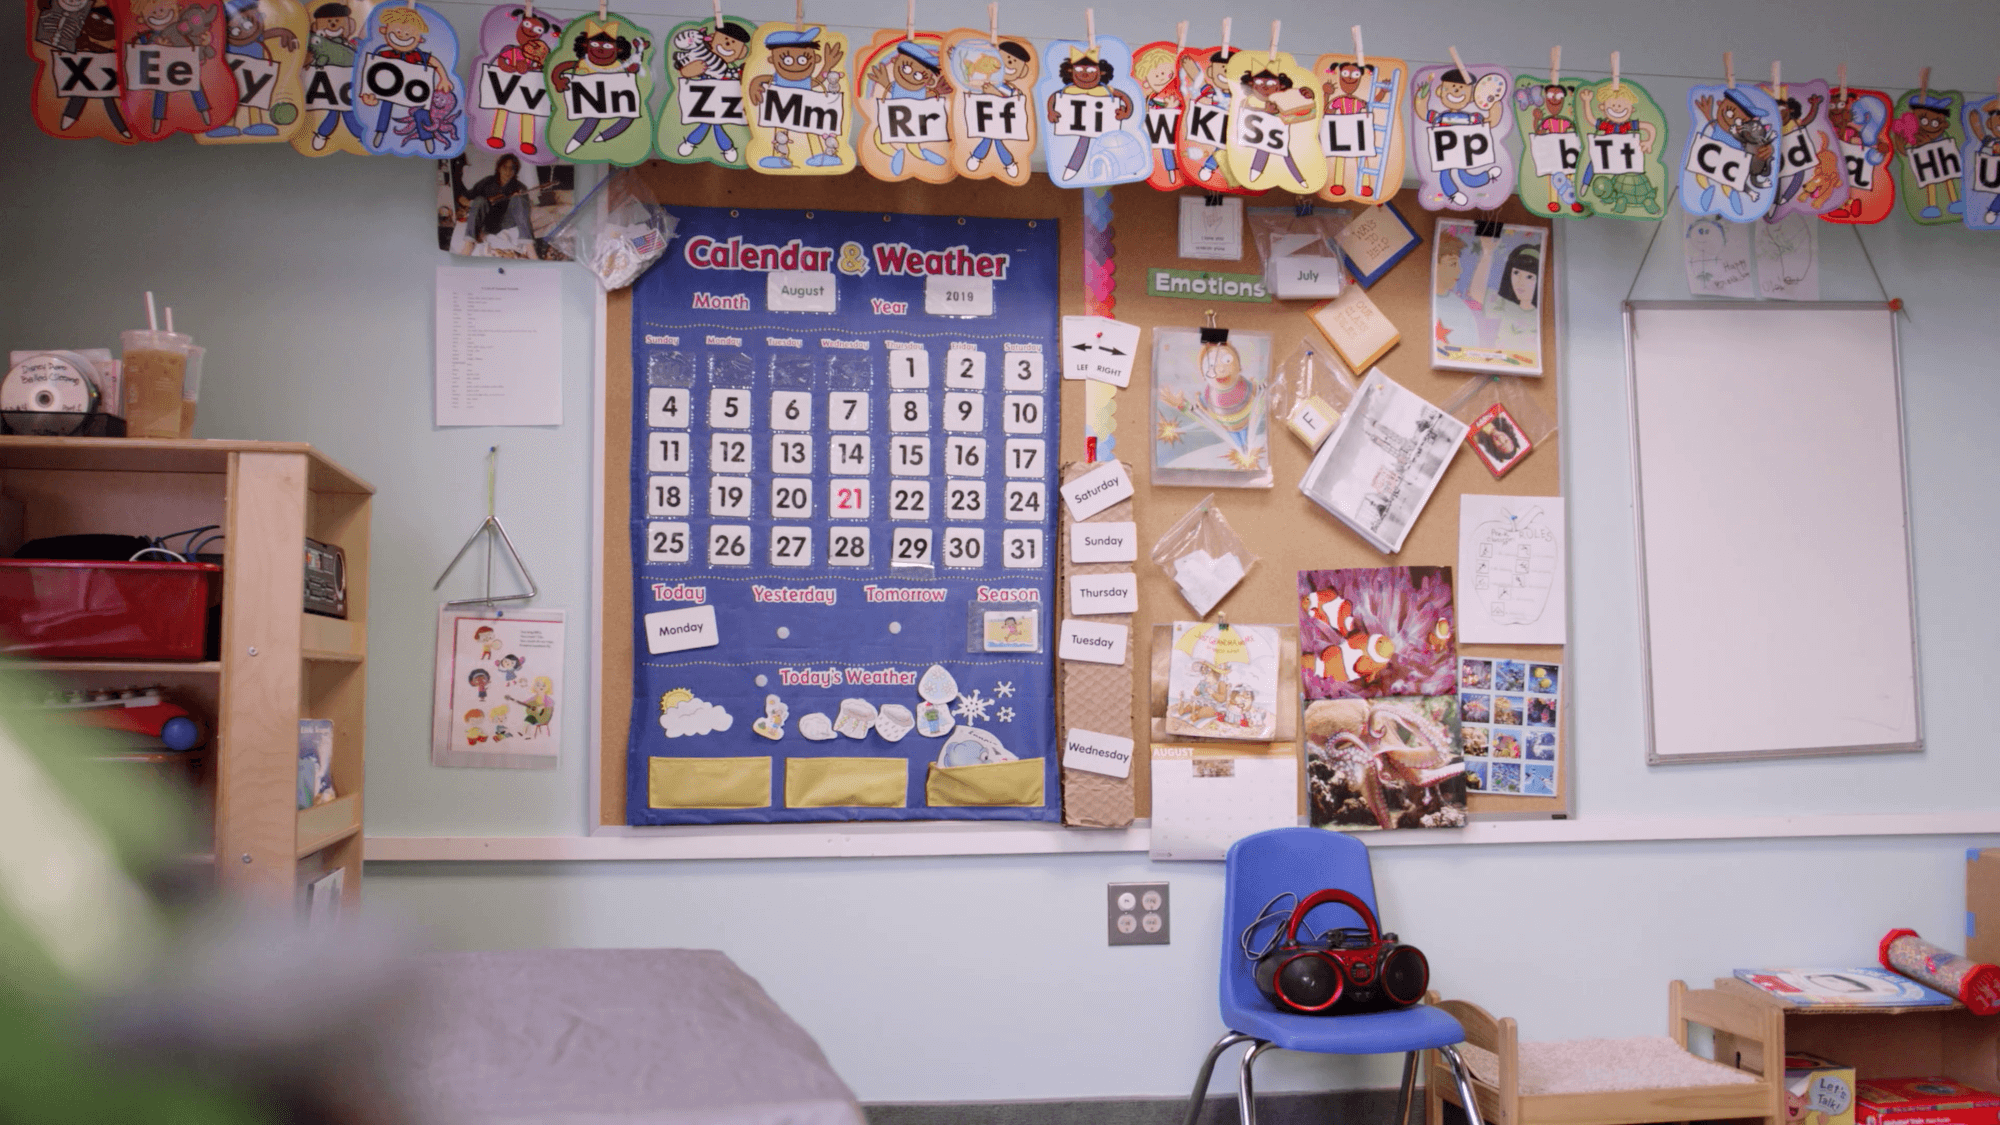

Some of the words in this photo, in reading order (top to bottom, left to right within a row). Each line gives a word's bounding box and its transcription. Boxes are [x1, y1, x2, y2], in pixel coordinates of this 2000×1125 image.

[139, 50, 193, 86] Ee
[367, 61, 431, 103] Oo
[487, 71, 546, 110] Vv
[572, 81, 637, 114] Nn
[688, 85, 744, 119] Zz
[764, 89, 838, 127] Mm
[888, 105, 941, 137] Rr
[976, 101, 1016, 134] Ff
[1069, 99, 1104, 133] Ii
[1242, 114, 1285, 150] Ss
[1328, 119, 1366, 151] Ll
[1434, 130, 1488, 166] Pp
[1594, 133, 1635, 169] Tt
[1779, 135, 1812, 174] d
[1697, 146, 1739, 182] Cc
[1913, 147, 1960, 182] Hh
[686, 237, 833, 273] Calendar
[839, 243, 868, 275] &
[875, 244, 1009, 279] Weather
[1156, 273, 1266, 297] Emotions
[1297, 271, 1319, 283] July
[693, 293, 750, 311] Month
[781, 284, 825, 299] August
[872, 299, 908, 315] Year
[946, 291, 974, 302] 2019
[645, 335, 679, 346] Sunday
[706, 336, 742, 347] Monday
[766, 337, 803, 348] Tuesday
[821, 338, 870, 350] Wednesday
[885, 340, 924, 350] Thursday
[950, 342, 977, 351] Friday
[1004, 342, 1043, 352] Saturday
[906, 358, 914, 377] 1
[961, 358, 973, 378] 2
[1018, 360, 1031, 380] 3
[1077, 364, 1089, 372] LEF
[1097, 365, 1121, 377] RIGHT
[662, 396, 677, 416] 4
[724, 397, 738, 417] 5
[785, 400, 799, 420] 6
[843, 400, 857, 420] 7
[904, 401, 917, 421] 8
[958, 401, 972, 420] 9
[1013, 403, 1037, 423] 10
[660, 440, 679, 461] 11
[720, 442, 745, 462] 12
[781, 442, 805, 463] 13
[839, 444, 863, 464] 14
[899, 445, 923, 465] 15
[955, 445, 979, 466] 16
[1013, 449, 1037, 468] 17
[656, 486, 680, 507] 18
[718, 486, 743, 507] 19
[777, 488, 807, 509] 20
[836, 488, 862, 510] 21
[895, 490, 924, 511] 22
[952, 490, 980, 511] 23
[1010, 492, 1039, 511] 24
[1074, 476, 1119, 503] Saturday
[654, 532, 683, 553] 25
[715, 535, 745, 556] 26
[777, 536, 806, 557] 27
[835, 536, 864, 557] 28
[898, 538, 927, 558] 29
[950, 538, 980, 558] 30
[1011, 539, 1034, 559] 31
[1085, 536, 1123, 547] Sunday
[652, 584, 706, 603] Today
[752, 586, 836, 605] Yesterday
[864, 586, 947, 603] Tomorrow
[977, 586, 1041, 602] Season
[1080, 588, 1128, 598] Thursday
[659, 620, 704, 637] Monday
[1072, 635, 1114, 649] Tuesday
[779, 668, 842, 688] Today's
[847, 669, 917, 685] Weather
[1068, 742, 1130, 763] Wednesday
[1152, 748, 1194, 757] AUGUST
[1817, 1093, 1841, 1111] Talk!
[1819, 1078, 1848, 1100] Let's
